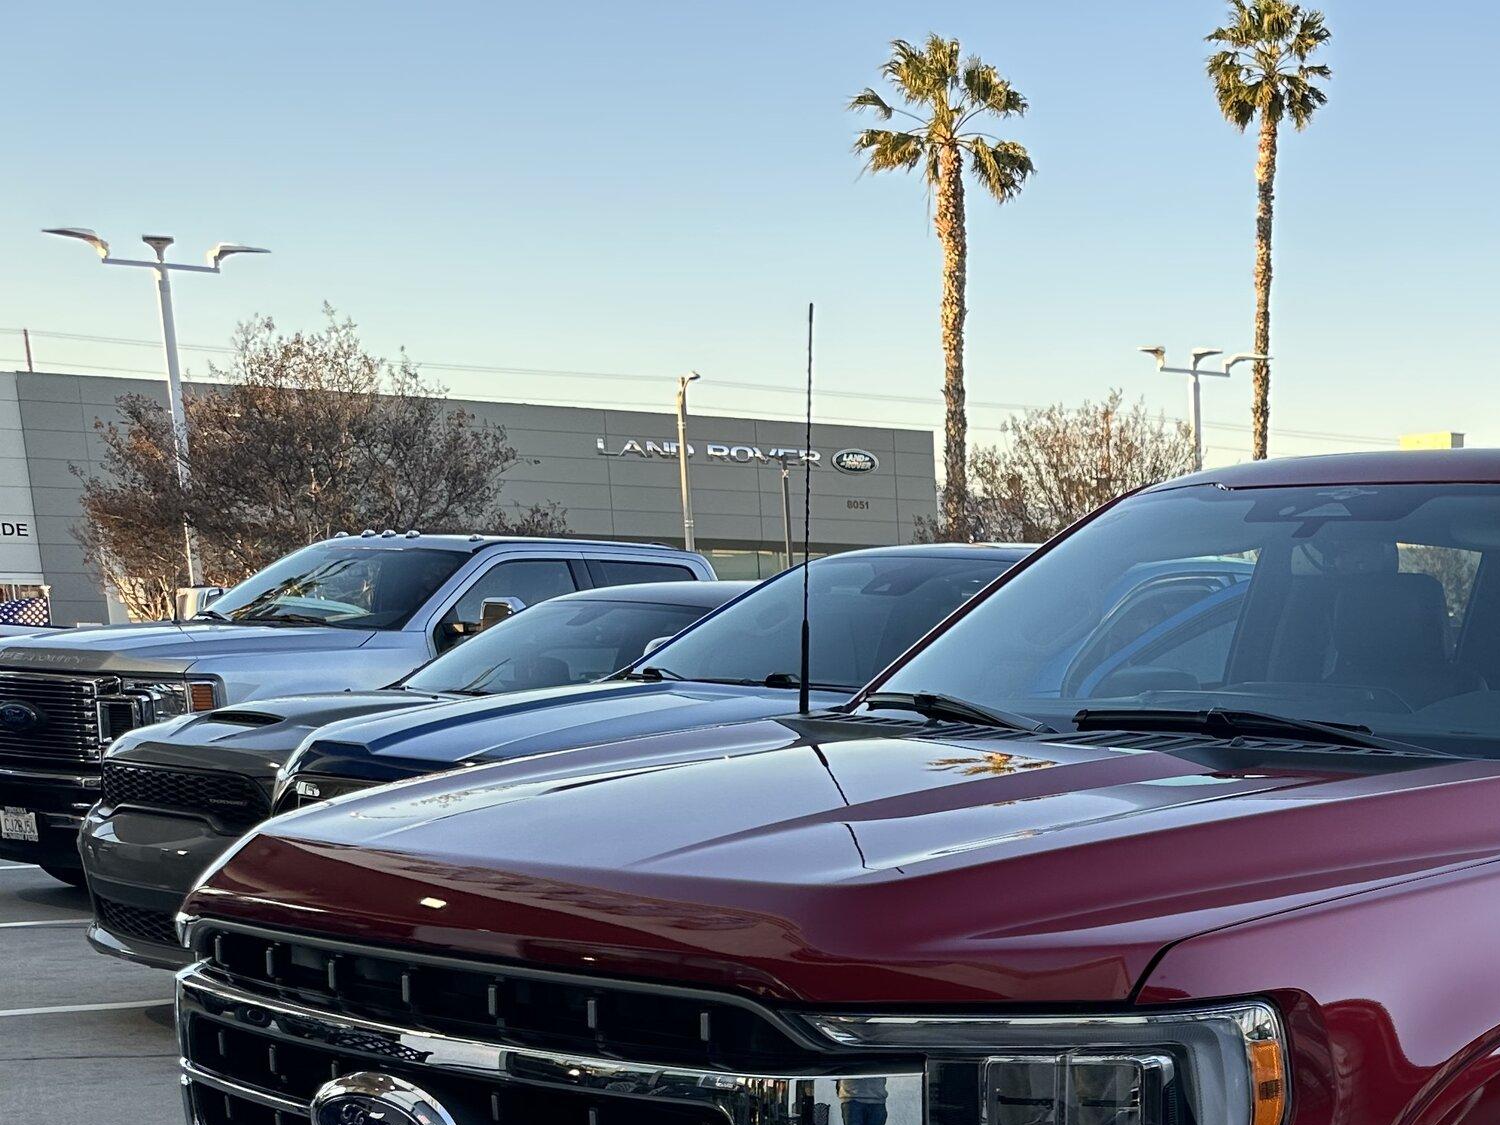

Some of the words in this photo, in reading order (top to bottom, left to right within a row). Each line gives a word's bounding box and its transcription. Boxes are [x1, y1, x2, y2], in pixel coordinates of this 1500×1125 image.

[597, 438, 695, 458] LAND
[706, 444, 821, 467] ROVER
[843, 453, 865, 462] LAND
[847, 500, 869, 510] 8051
[0, 522, 29, 537] DE
